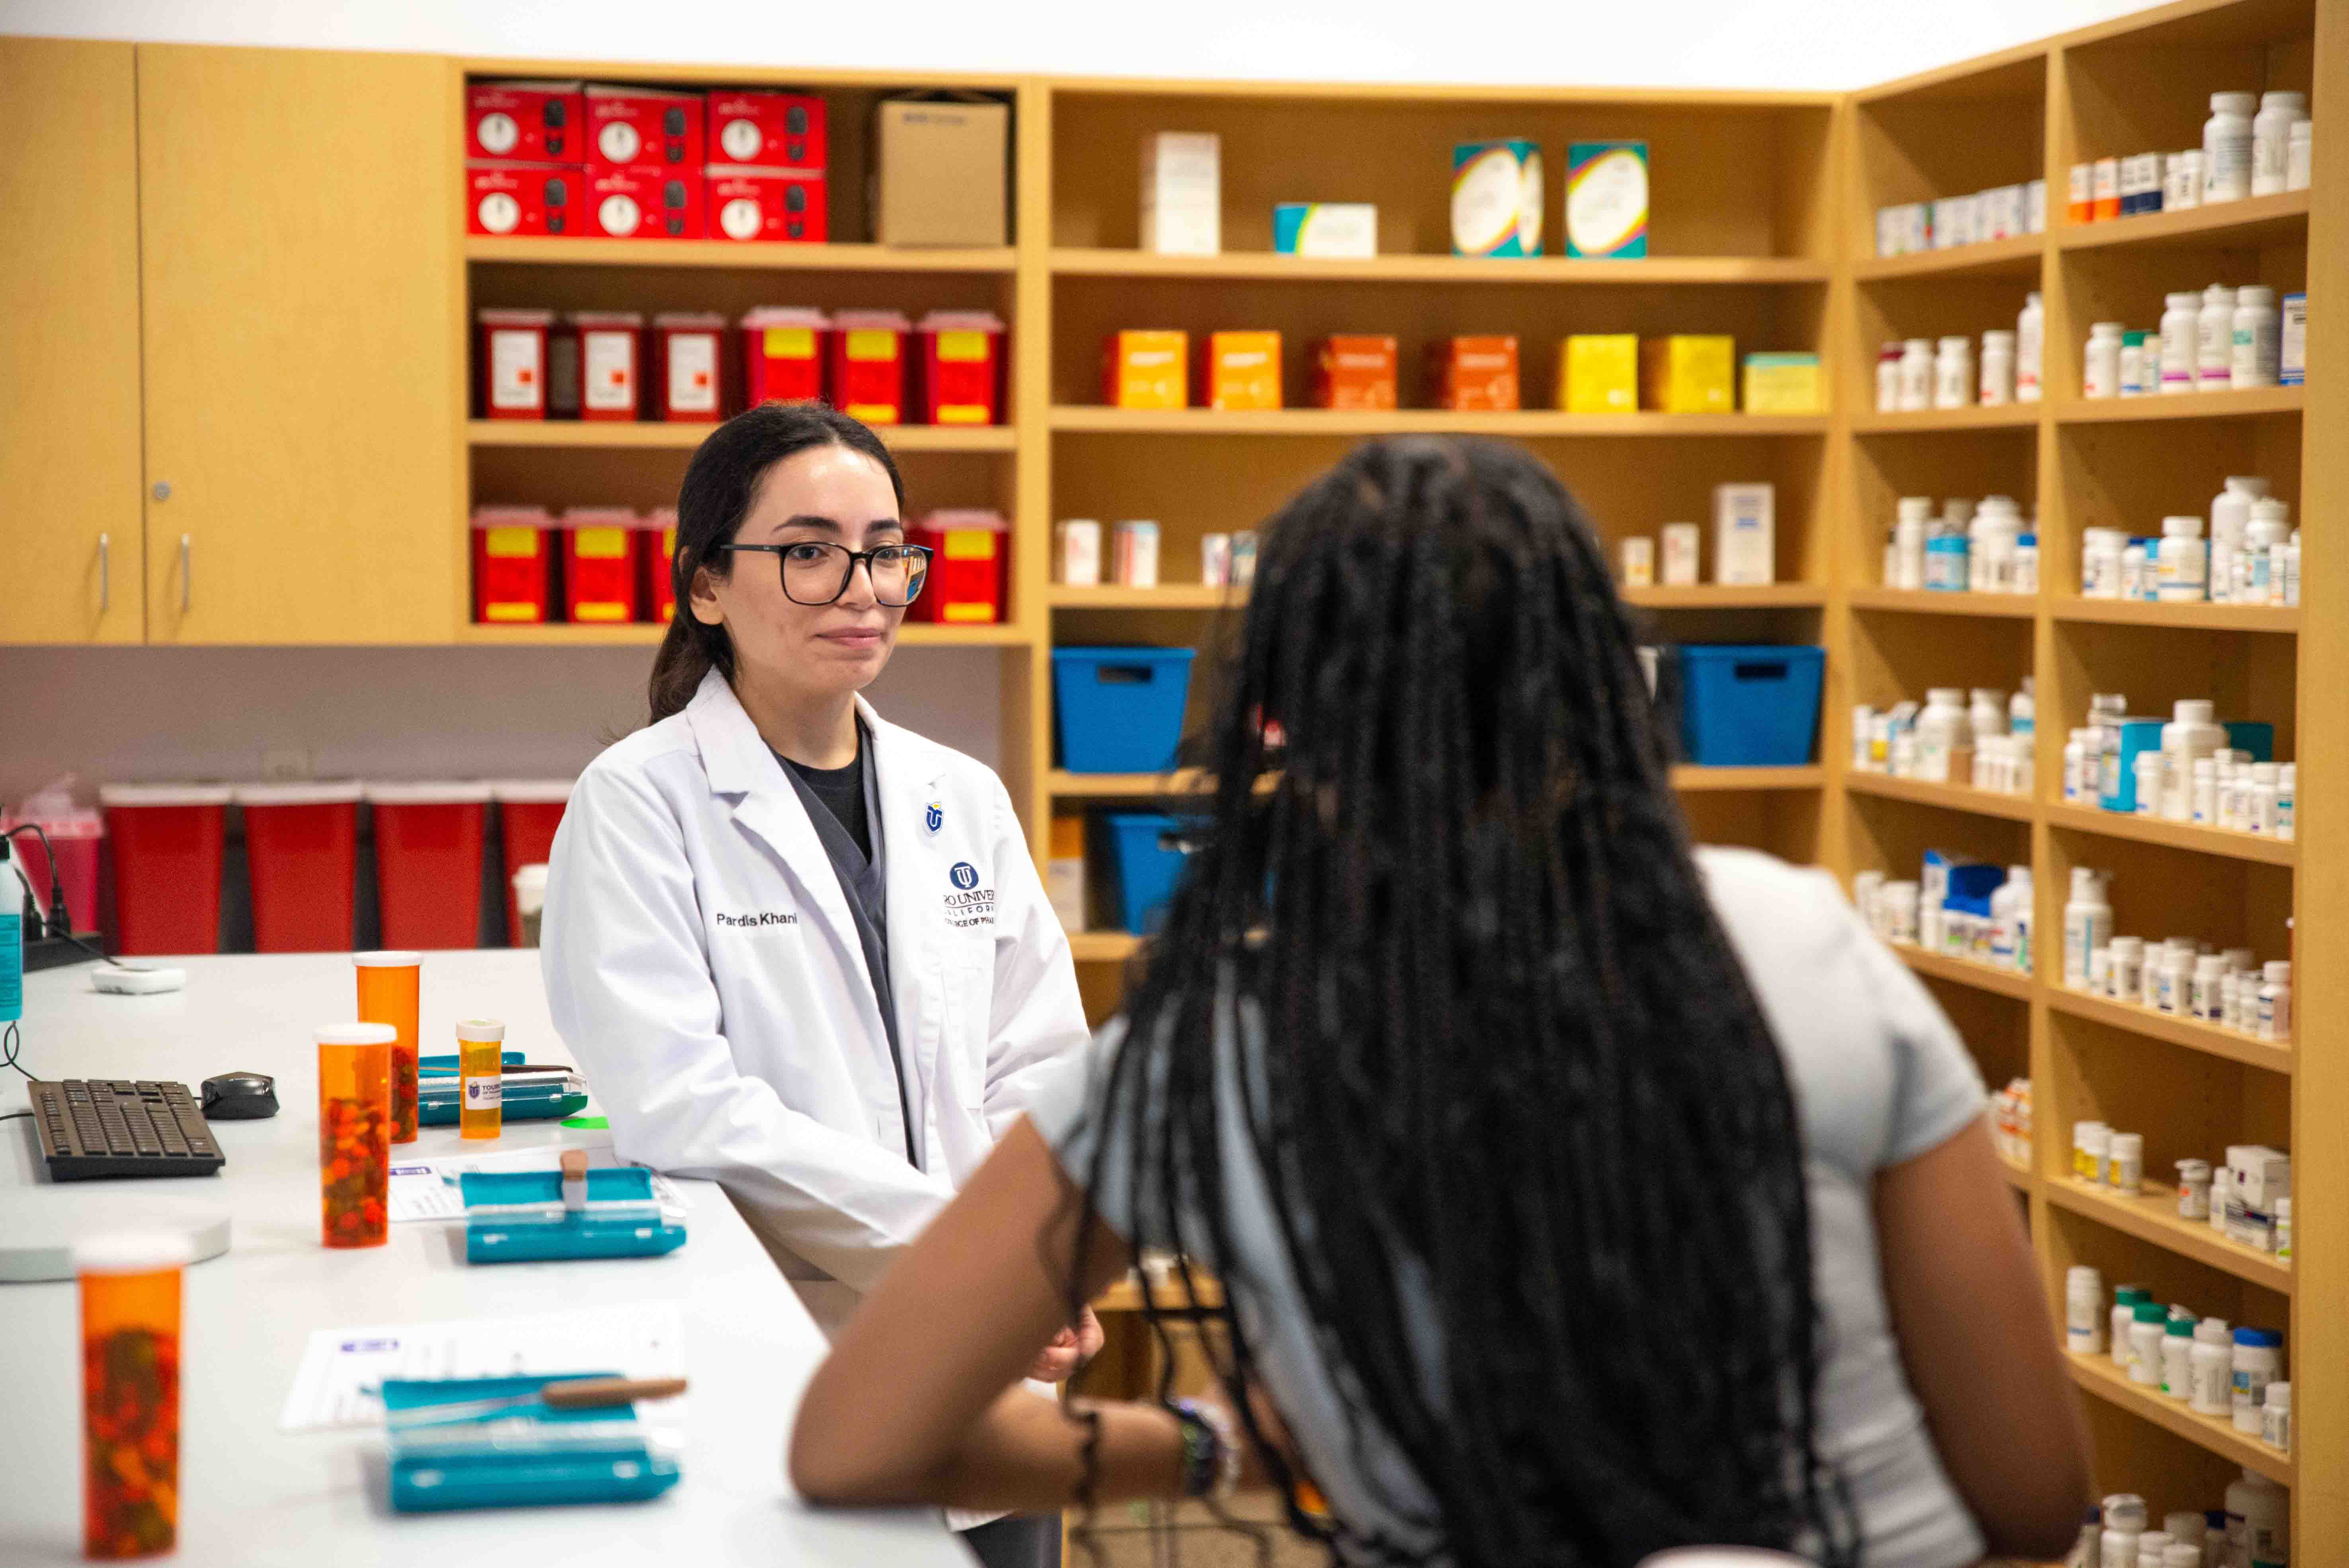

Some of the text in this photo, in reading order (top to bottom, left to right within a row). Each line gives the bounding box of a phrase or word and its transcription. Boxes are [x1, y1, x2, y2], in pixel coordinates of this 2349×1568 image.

[716, 912, 798, 927] Pardis Khani
[969, 918, 979, 926] OF
